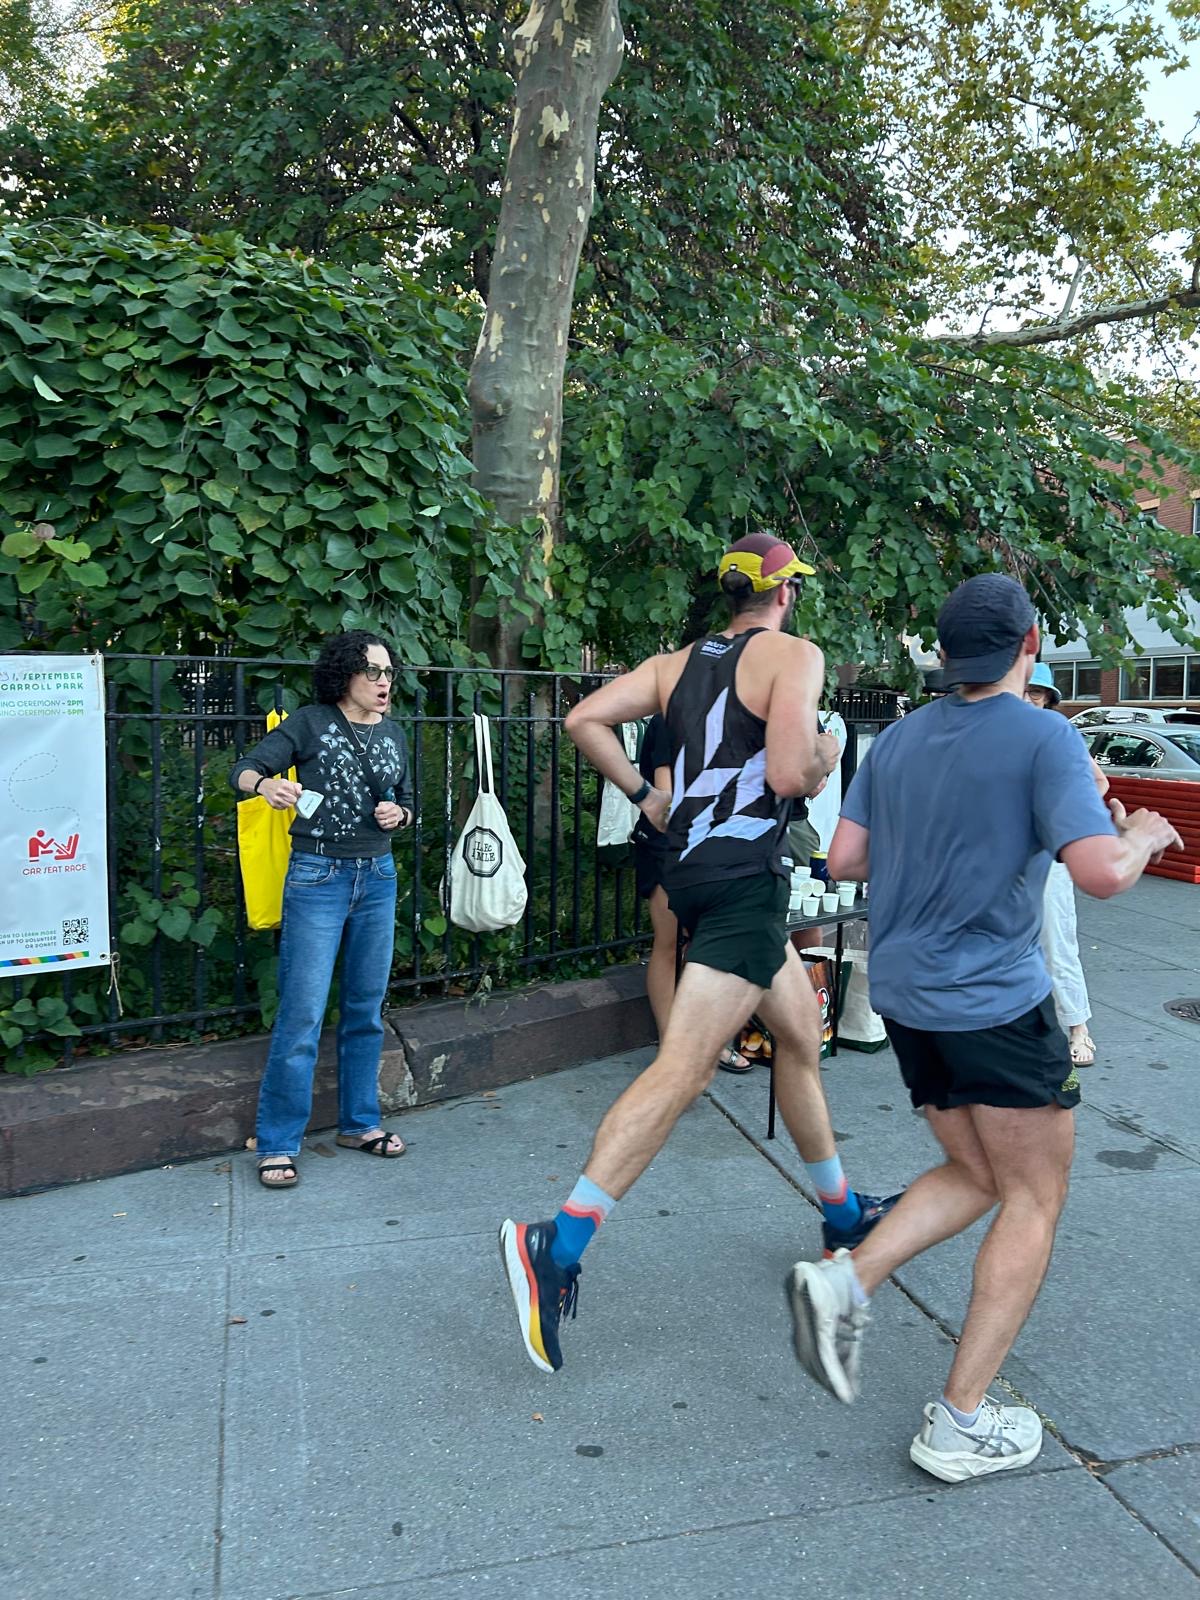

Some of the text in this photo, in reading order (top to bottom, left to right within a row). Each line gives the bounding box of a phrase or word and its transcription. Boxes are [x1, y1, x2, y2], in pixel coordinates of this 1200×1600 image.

[23, 672, 83, 680] SEPTEMBER
[56, 682, 84, 690] PARK
[43, 866, 63, 874] SEAT
[65, 864, 87, 872] RACE
